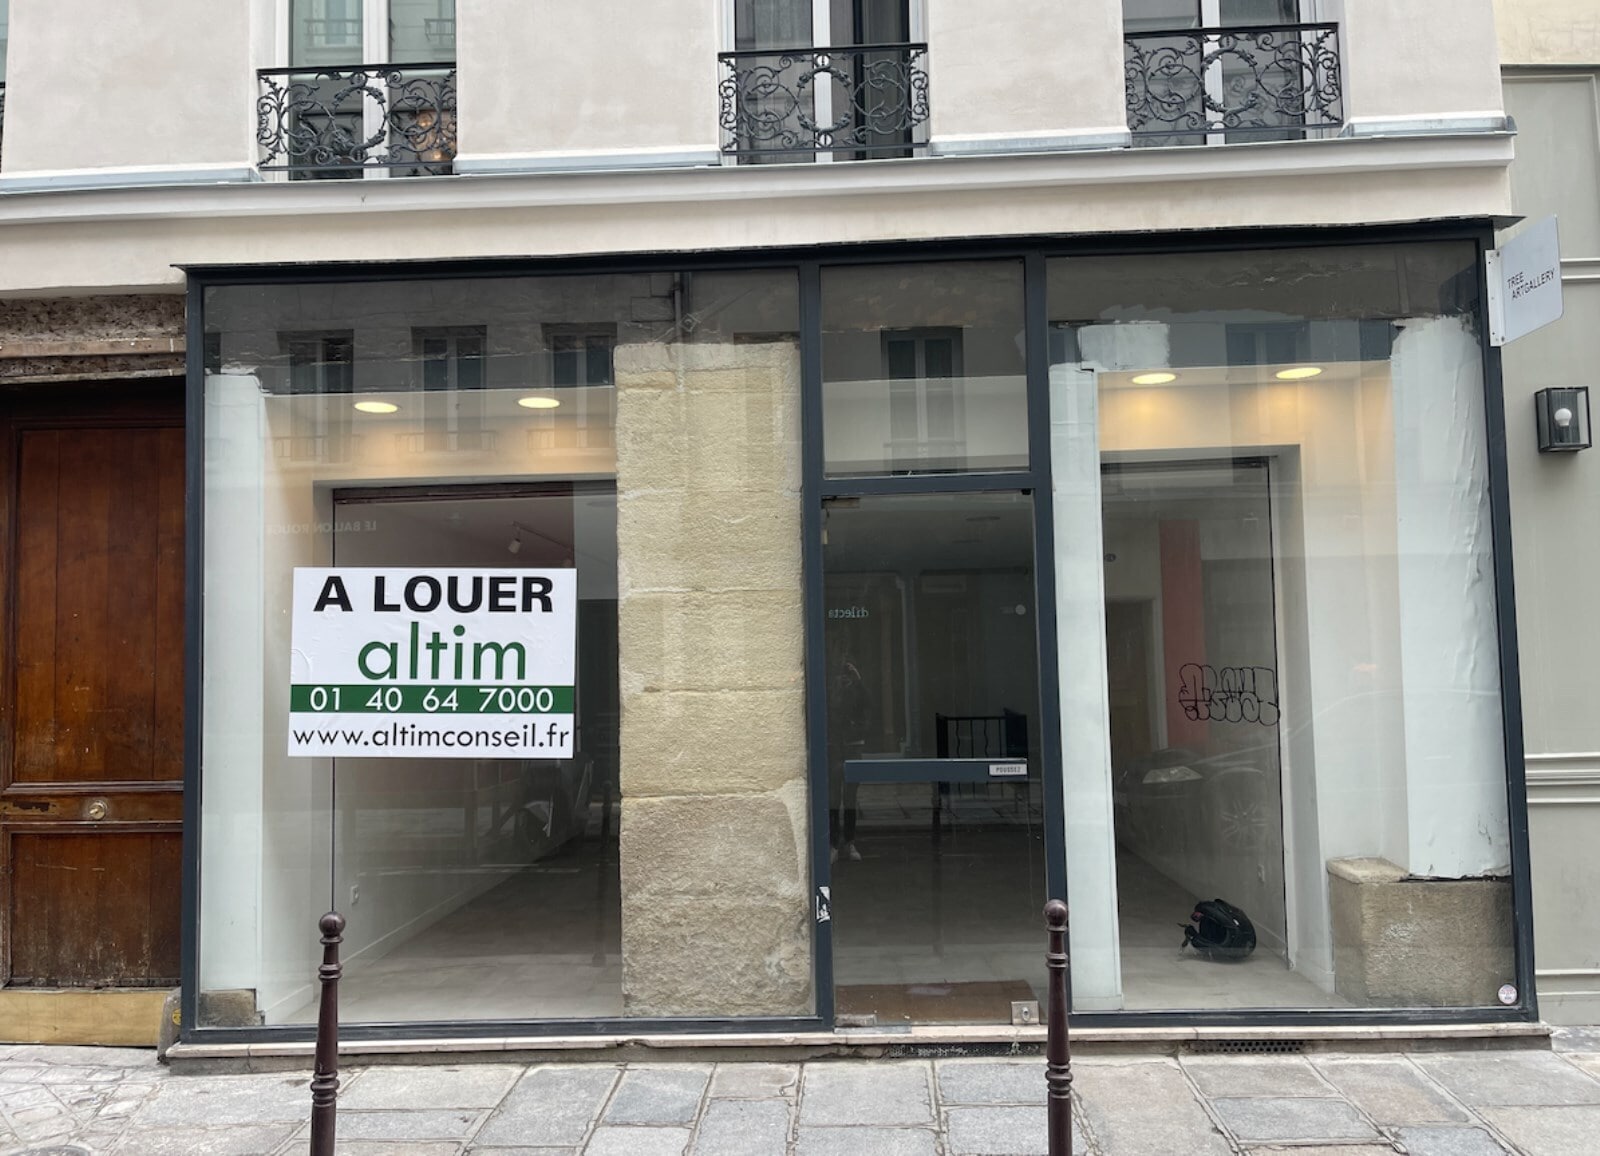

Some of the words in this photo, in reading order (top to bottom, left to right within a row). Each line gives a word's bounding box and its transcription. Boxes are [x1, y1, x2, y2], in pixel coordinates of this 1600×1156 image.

[1507, 271, 1524, 289] TREE
[1511, 267, 1554, 299] ARTGALLERY
[313, 576, 353, 612] A
[373, 576, 554, 613] LOUER
[357, 621, 526, 681] altim
[310, 687, 341, 711] 01
[365, 687, 402, 712] 40
[422, 687, 459, 712] 64
[478, 688, 554, 712] 7000
[293, 722, 570, 748] www.altimconseil.fr
